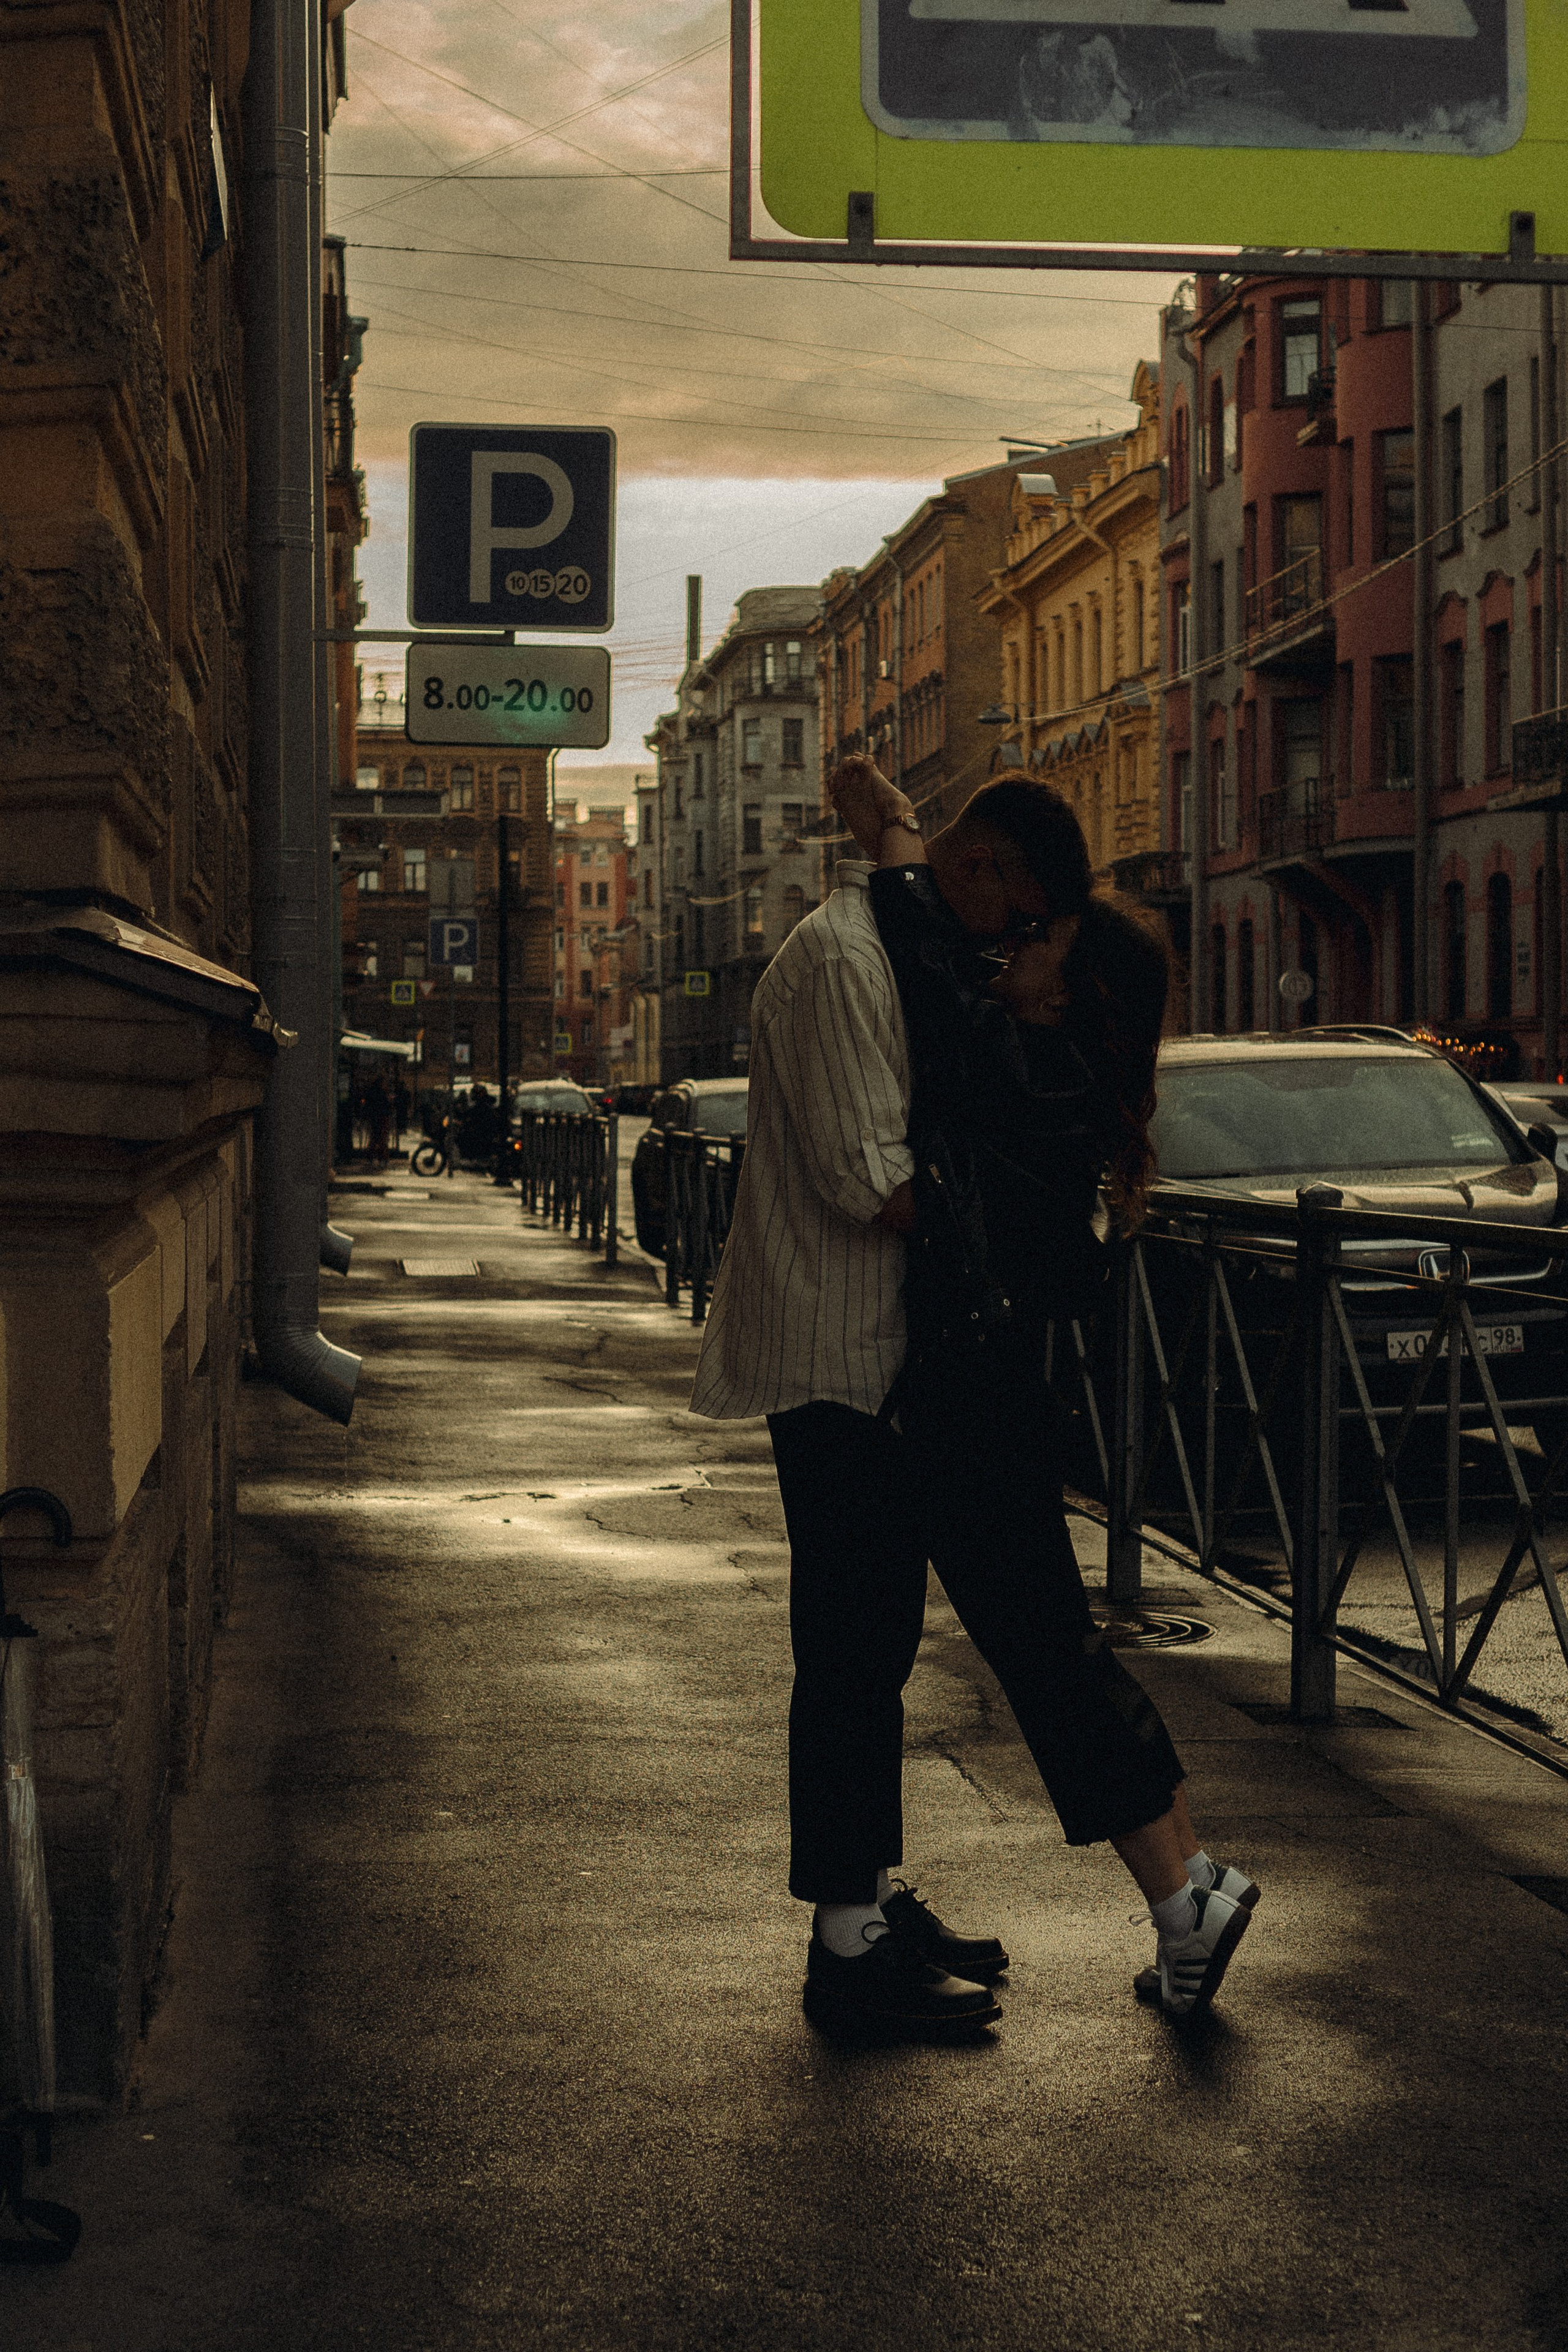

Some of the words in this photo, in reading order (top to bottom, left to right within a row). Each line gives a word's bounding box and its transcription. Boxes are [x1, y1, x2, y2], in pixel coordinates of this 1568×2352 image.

[469, 451, 575, 603] P
[510, 576, 526, 589] 10
[532, 575, 551, 592] 15
[558, 573, 587, 595] 20
[423, 676, 593, 713] 8.00-20.00
[443, 923, 469, 960] P
